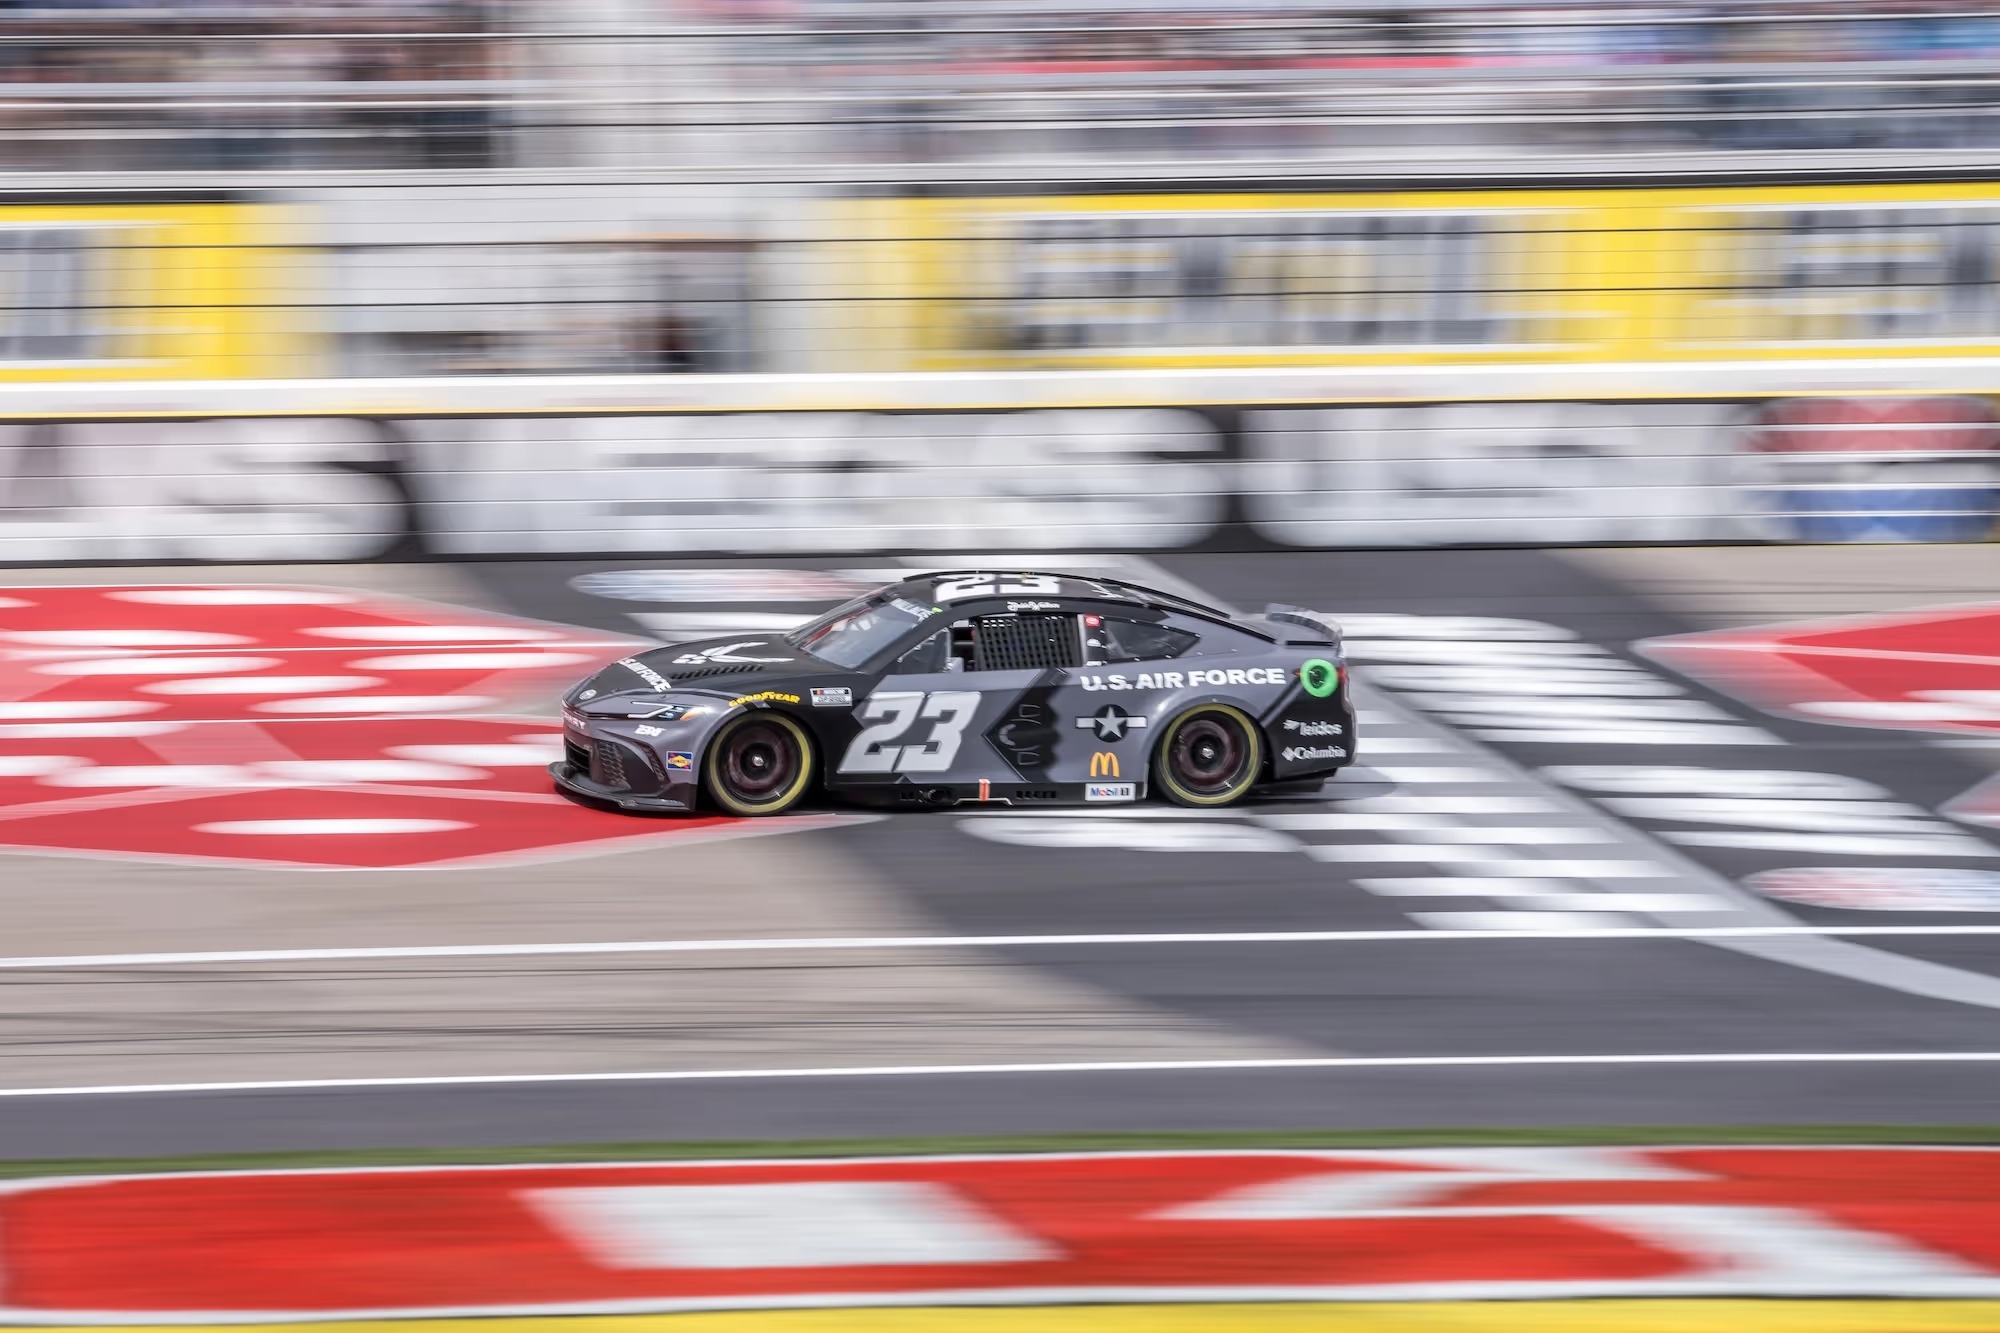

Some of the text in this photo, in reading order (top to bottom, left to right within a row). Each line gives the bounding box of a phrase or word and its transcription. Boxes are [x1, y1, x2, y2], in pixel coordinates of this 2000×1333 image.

[934, 573, 1060, 602] 23
[1080, 668, 1286, 691] U.S. AIR FORCE
[729, 691, 800, 707] GOODYEAR
[837, 691, 982, 773] 23
[1300, 721, 1343, 736] leidos
[1294, 745, 1347, 760] Columbia
[1090, 787, 1118, 797] Mobil
